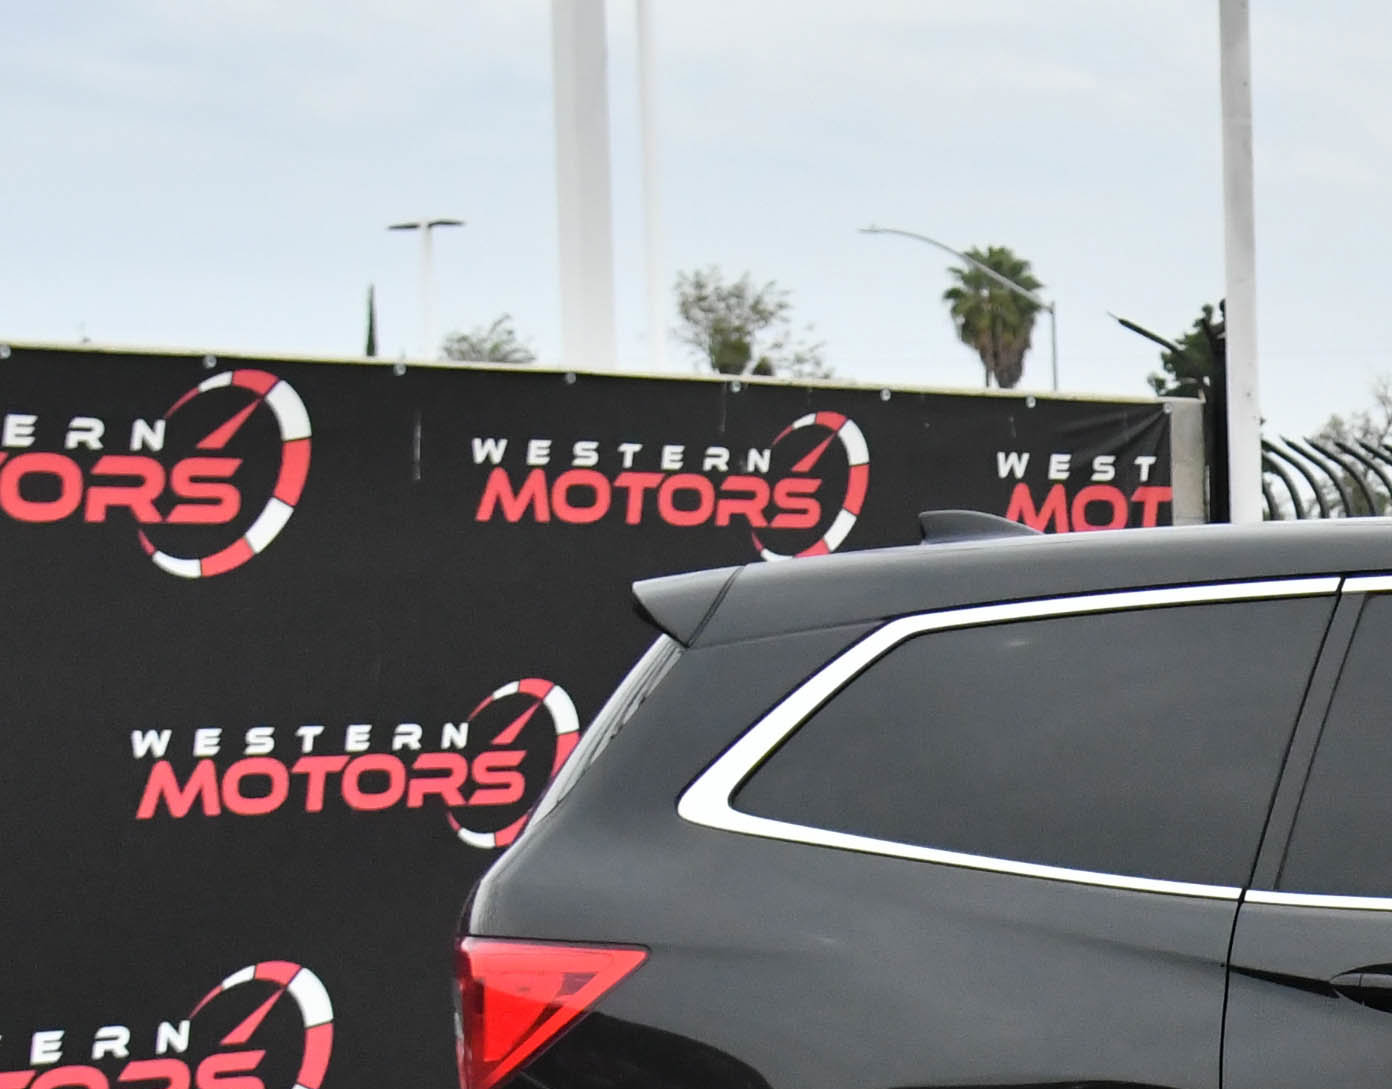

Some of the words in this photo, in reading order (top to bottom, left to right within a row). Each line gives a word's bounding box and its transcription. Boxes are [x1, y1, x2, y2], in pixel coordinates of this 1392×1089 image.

[472, 437, 771, 473] WESTERN
[996, 451, 1158, 483] WEST
[0, 452, 243, 524] ORS
[475, 467, 822, 529] MOTORS
[1005, 481, 1173, 535] MOT
[131, 722, 469, 758] WESTERN
[135, 750, 528, 820] MOTORS
[0, 1020, 191, 1065] ERN
